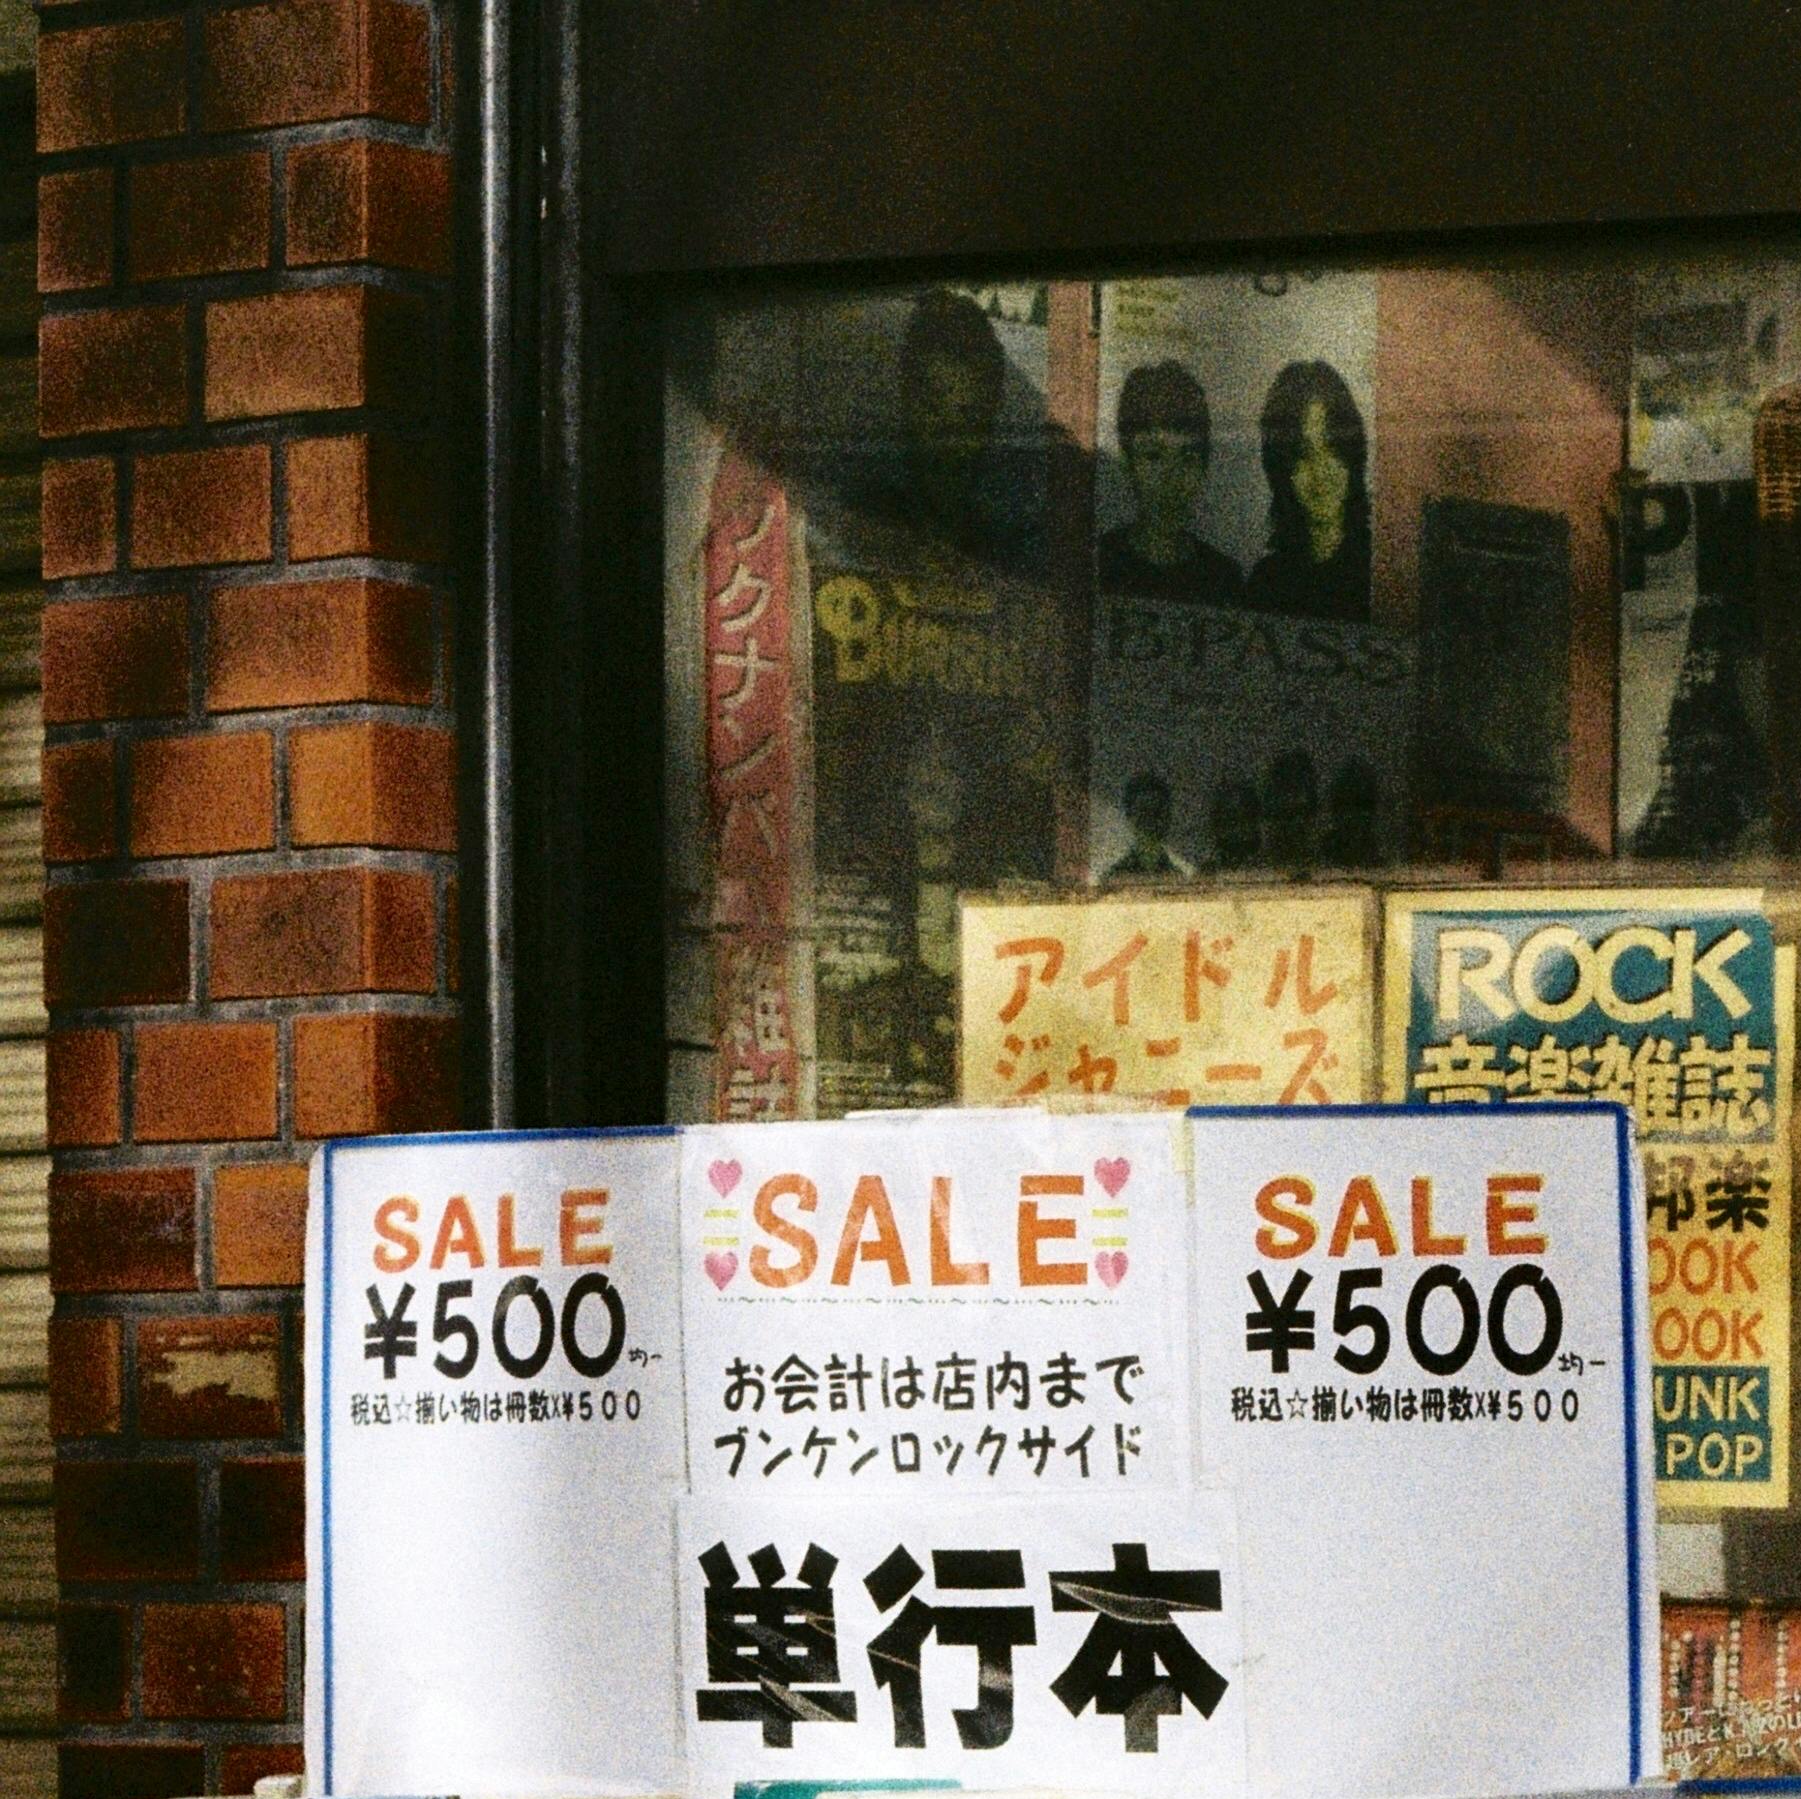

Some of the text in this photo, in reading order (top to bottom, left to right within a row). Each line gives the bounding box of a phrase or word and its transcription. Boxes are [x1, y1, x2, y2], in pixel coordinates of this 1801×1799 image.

[993, 928, 1338, 1026] アイドル
[1437, 924, 1756, 1024] ROCK
[372, 1186, 614, 1273] SALE
[747, 1172, 1089, 1290] SALE
[1254, 1173, 1550, 1260] SALE
[362, 1272, 627, 1381] ¥500
[1245, 1263, 1563, 1376] ¥500
[722, 1350, 1146, 1414] お会計は店内まで
[714, 1422, 1143, 1478] ブンケンロックサイド
[1666, 1430, 1764, 1478] POP
[695, 1540, 1230, 1754] 単行本
